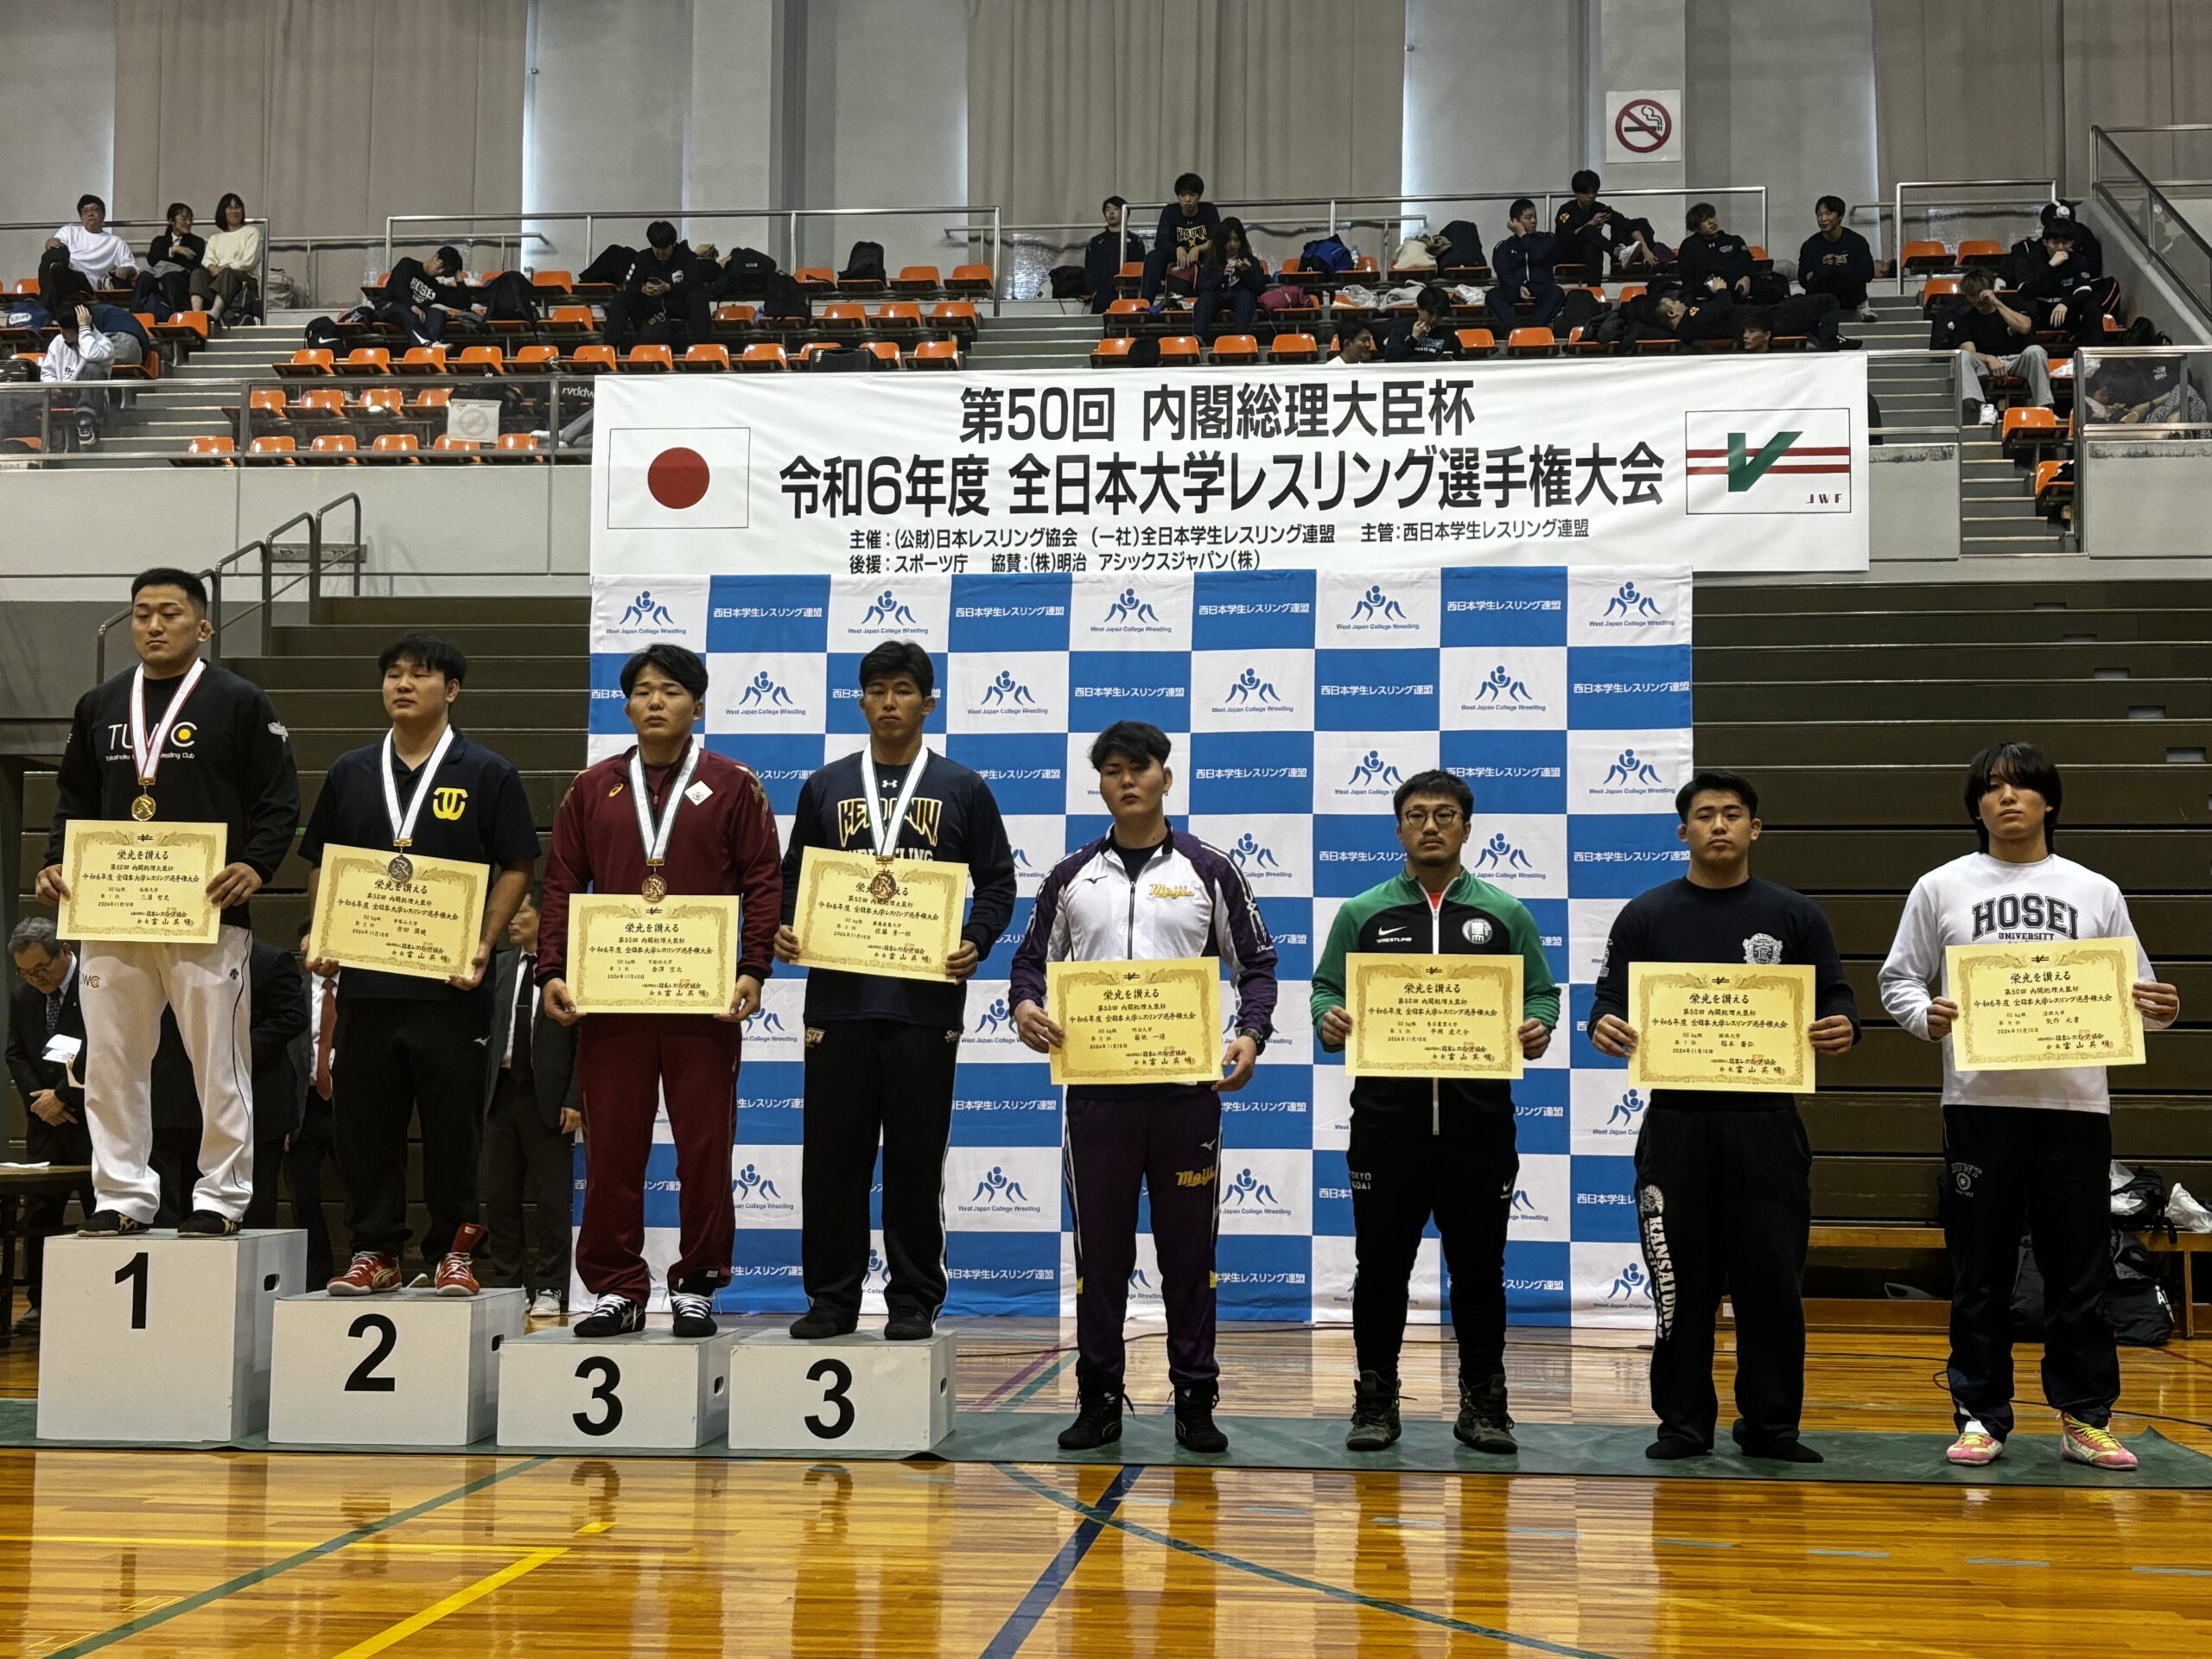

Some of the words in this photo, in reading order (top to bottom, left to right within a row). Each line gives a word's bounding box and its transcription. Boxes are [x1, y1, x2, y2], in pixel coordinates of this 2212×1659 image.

[960, 387, 1115, 443] 第50回
[1143, 379, 1475, 441] 内閣総理大臣杯
[779, 454, 989, 518] 令和6年度
[1008, 440, 1664, 516] 全日本大学レスリング選手権大会
[1099, 550, 1260, 571] アシックスジャパン(株)
[956, 607, 1065, 617] 西日本学生レスリング連盟
[1199, 603, 1310, 614] 西日本学生レスリング連盟
[1447, 601, 1561, 611] 西日本学生レスリング連盟
[714, 607, 823, 618] 西日本学生レスリング連盟
[1075, 687, 1184, 697] 西日本学生レスリング連盟
[1321, 684, 1433, 696] 西日本学生レスリング連盟
[1573, 682, 1690, 693] 西日本学生レスリング連盟
[1196, 767, 1307, 779] 西日本学生レスリング連盟
[1971, 893, 2079, 942] HOSEI
[1998, 931, 2055, 941] UNIVERSITY
[951, 1100, 1057, 1111] 日本学生レスリング連盟
[115, 1252, 149, 1329] 1
[344, 1313, 397, 1391] 2
[573, 1357, 623, 1436] 3
[804, 1358, 855, 1439] 3
